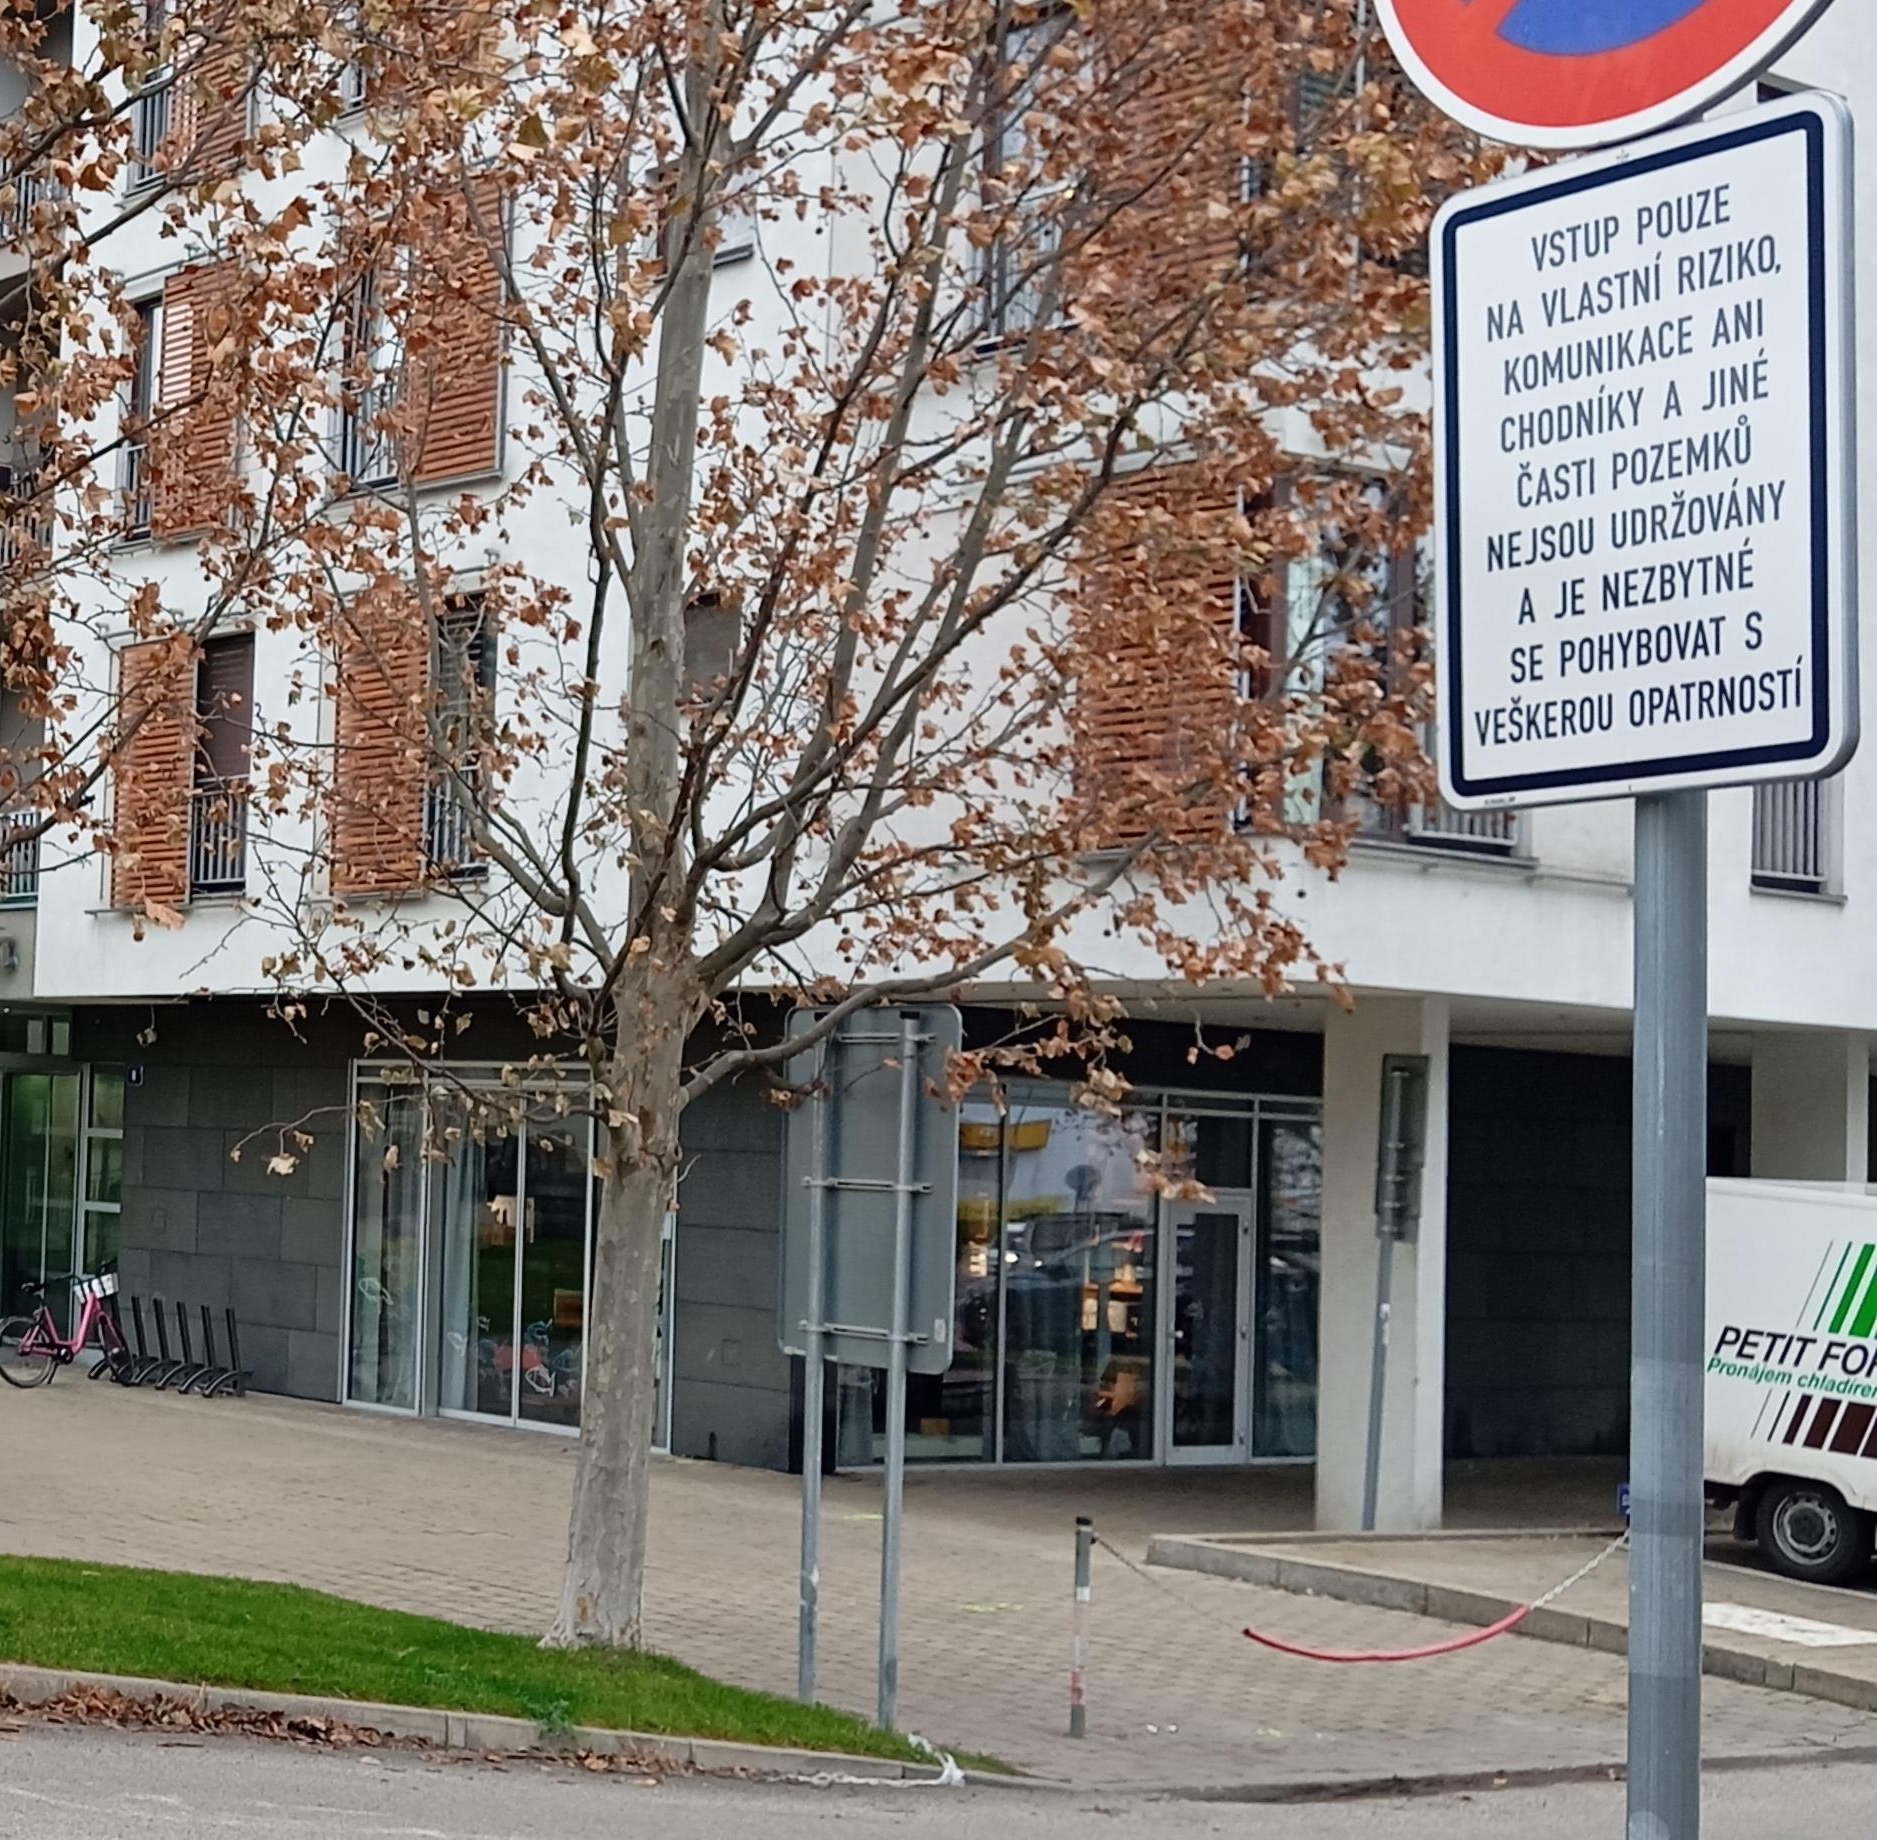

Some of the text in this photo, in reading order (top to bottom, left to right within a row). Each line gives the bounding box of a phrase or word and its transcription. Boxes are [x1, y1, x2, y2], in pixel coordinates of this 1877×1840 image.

[1531, 184, 1730, 272] VSTUP POUZE
[1487, 235, 1781, 342] NA VLASTNÍ RIZIKO,
[1504, 298, 1763, 395] KOMUNIKACE ANI
[1501, 352, 1768, 453] CHODNÍKY A JINÉ
[1517, 414, 1751, 508] ČASTI POZEMKŮ
[1487, 477, 1785, 572] NEJSOU UDRŽOVÁNY
[1518, 548, 1753, 625] A JE NEZBYTNÉ
[1511, 611, 1762, 684] SE POHYBOVAT S
[1474, 655, 1803, 747] VEŠKEROU OPATRNOSTÍ
[1707, 1357, 1792, 1384] Pronájem
[1714, 1325, 1817, 1366] PETIT
